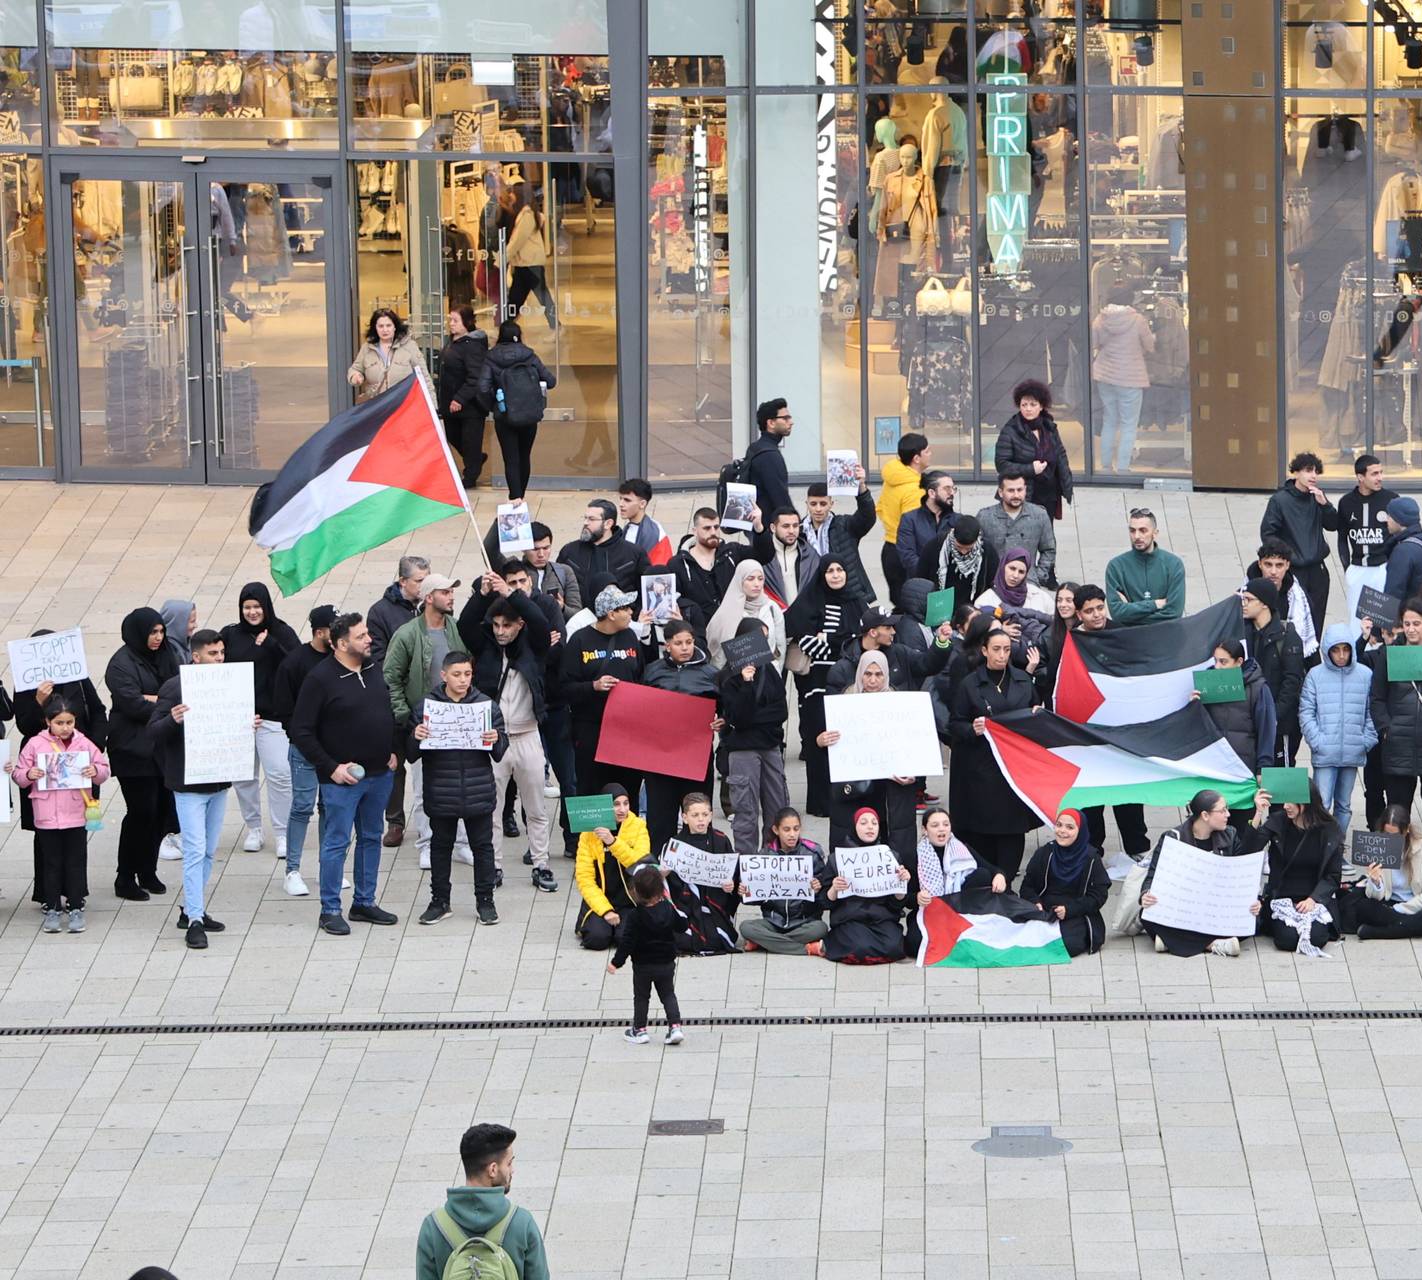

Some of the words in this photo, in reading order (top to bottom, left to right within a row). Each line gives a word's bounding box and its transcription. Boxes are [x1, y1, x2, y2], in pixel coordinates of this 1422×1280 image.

[1349, 528, 1383, 541] QATAR
[22, 661, 82, 684] GENOZID
[749, 856, 806, 872] STOPPT
[841, 851, 871, 866] WO
[854, 864, 893, 879] EURE
[755, 888, 808, 898] GAZA
